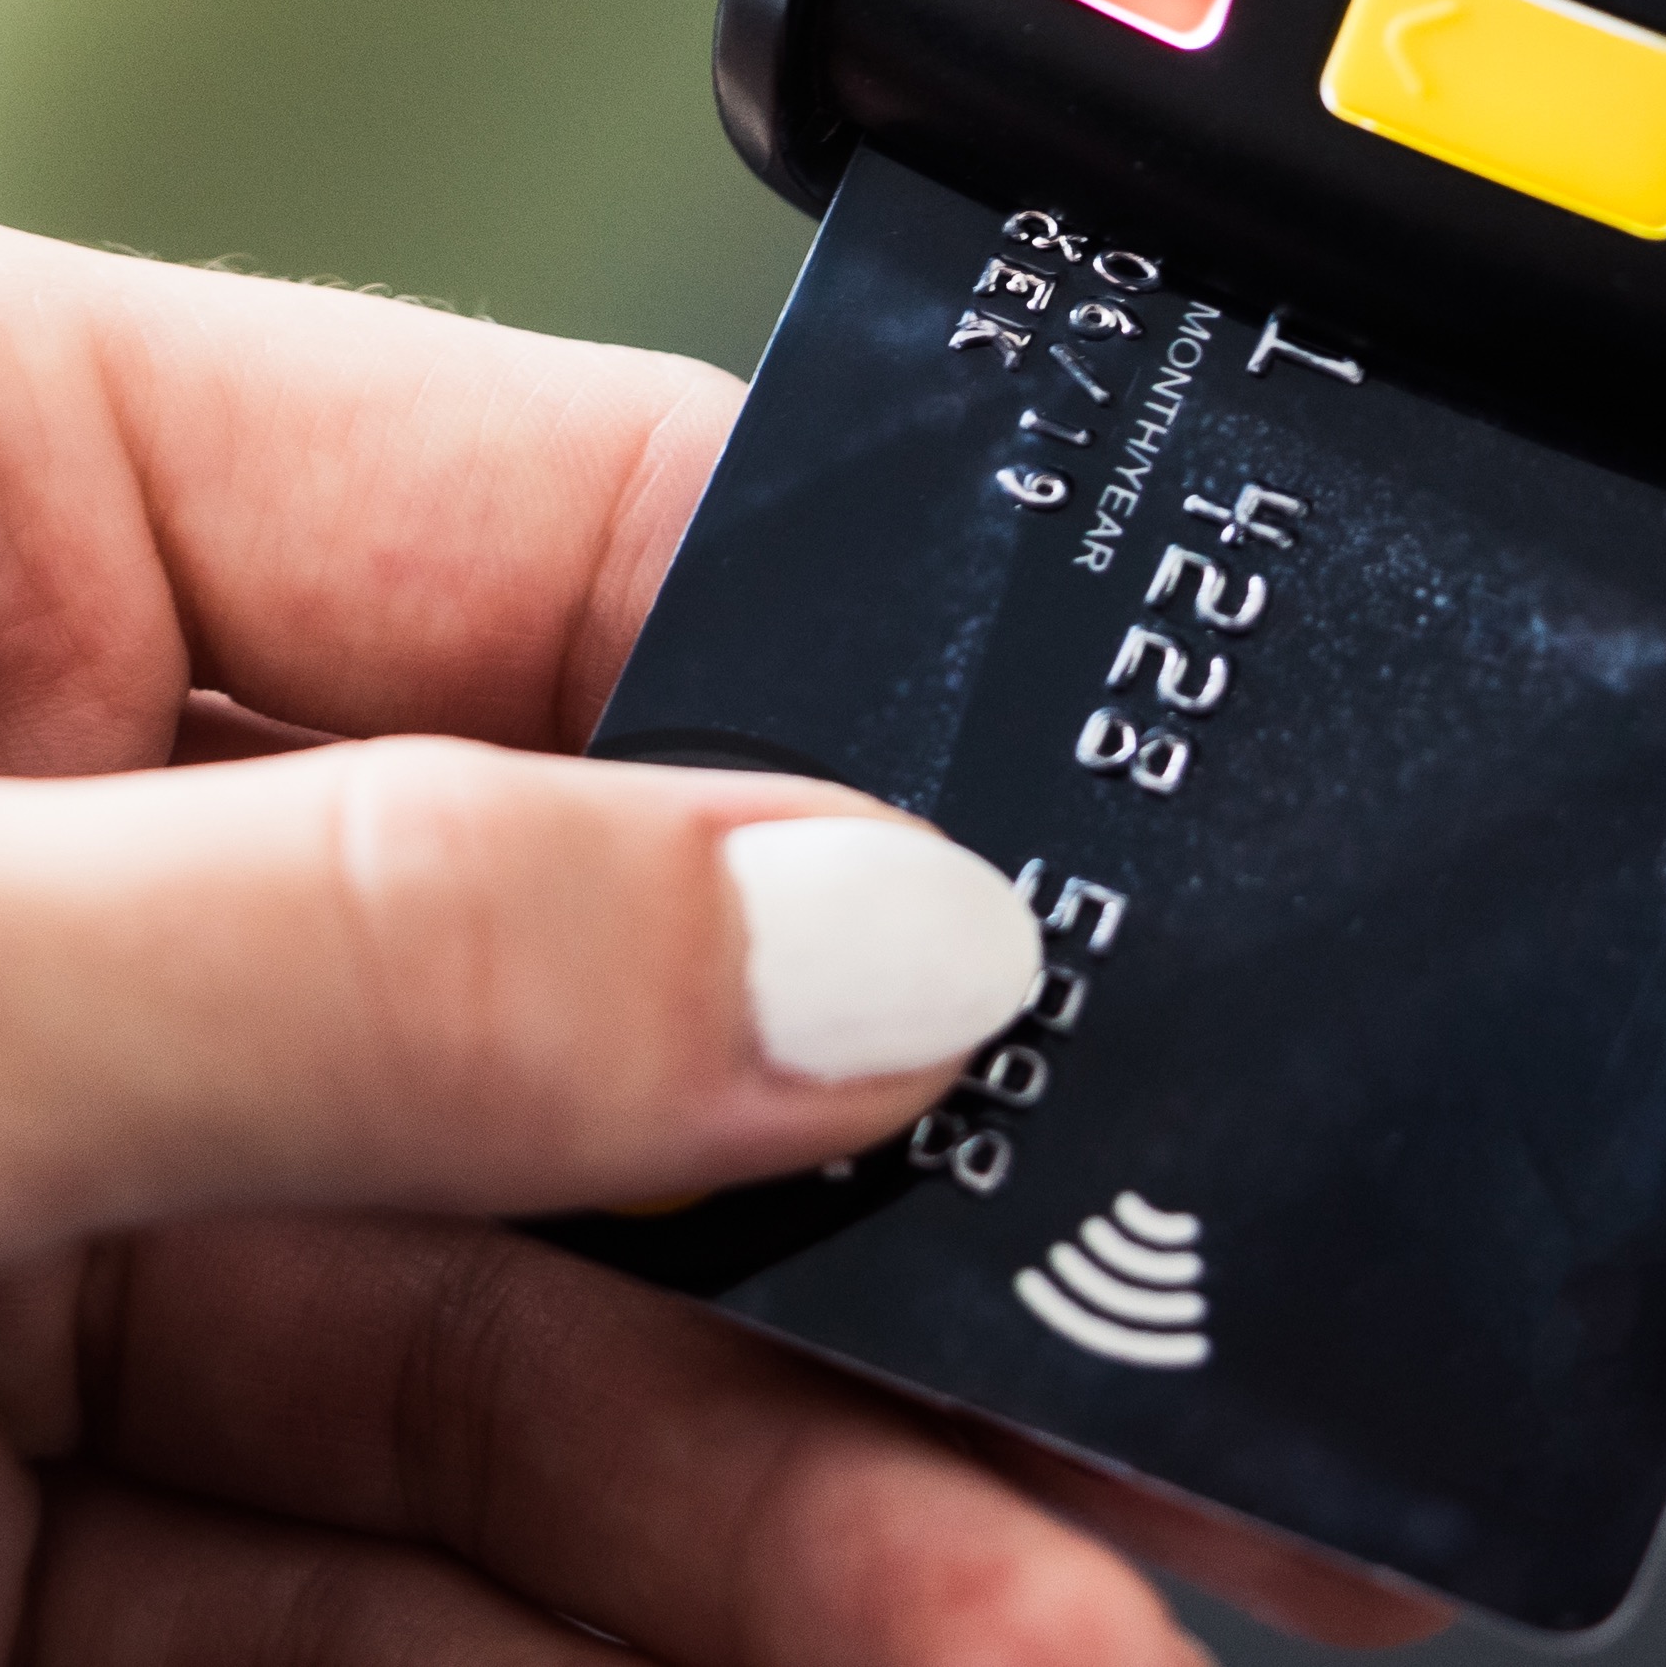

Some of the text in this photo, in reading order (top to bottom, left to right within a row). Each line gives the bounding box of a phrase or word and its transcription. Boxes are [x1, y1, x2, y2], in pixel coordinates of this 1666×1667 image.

[995, 251, 1162, 507] 06/19
[1071, 301, 1222, 573] MONTH/YEAR
[1075, 484, 1309, 795] 4228
